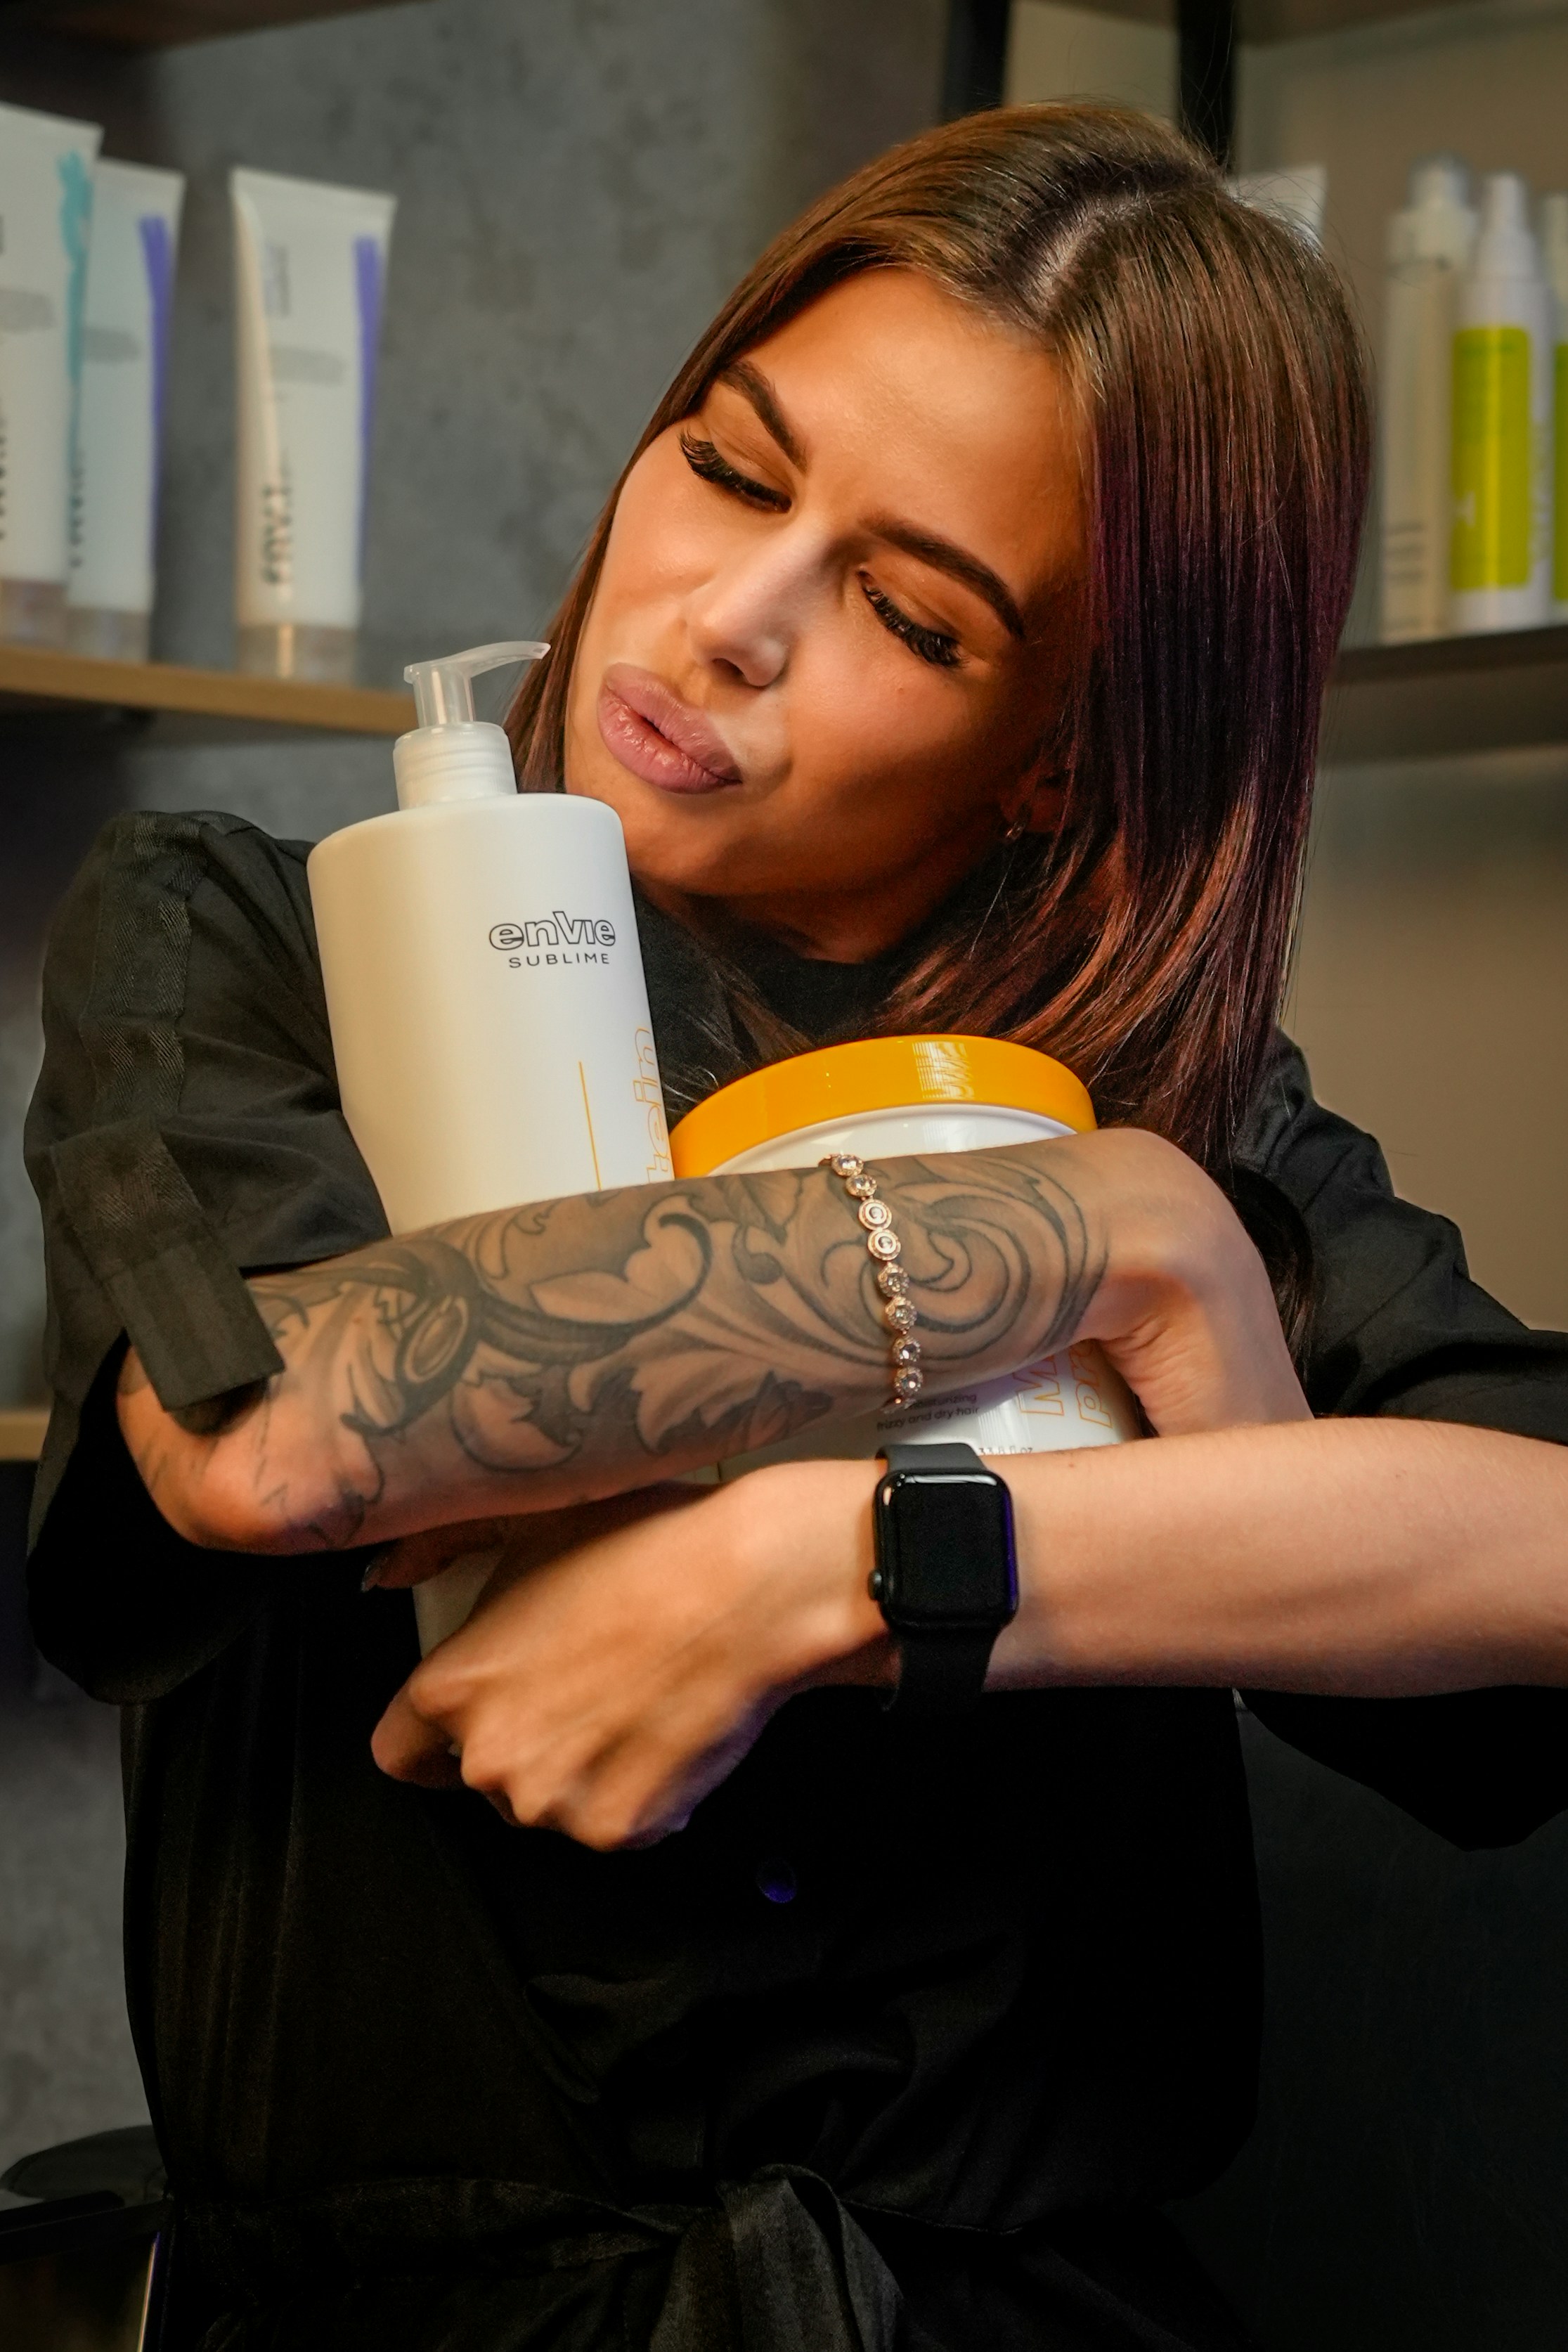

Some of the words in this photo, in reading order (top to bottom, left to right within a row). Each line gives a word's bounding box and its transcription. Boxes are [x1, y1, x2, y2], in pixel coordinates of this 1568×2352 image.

[509, 952, 611, 969] SUBLIME
[876, 1418, 906, 1431] frizzy
[908, 1412, 932, 1424] and
[934, 1409, 954, 1420] dry
[955, 1406, 980, 1416] hair
